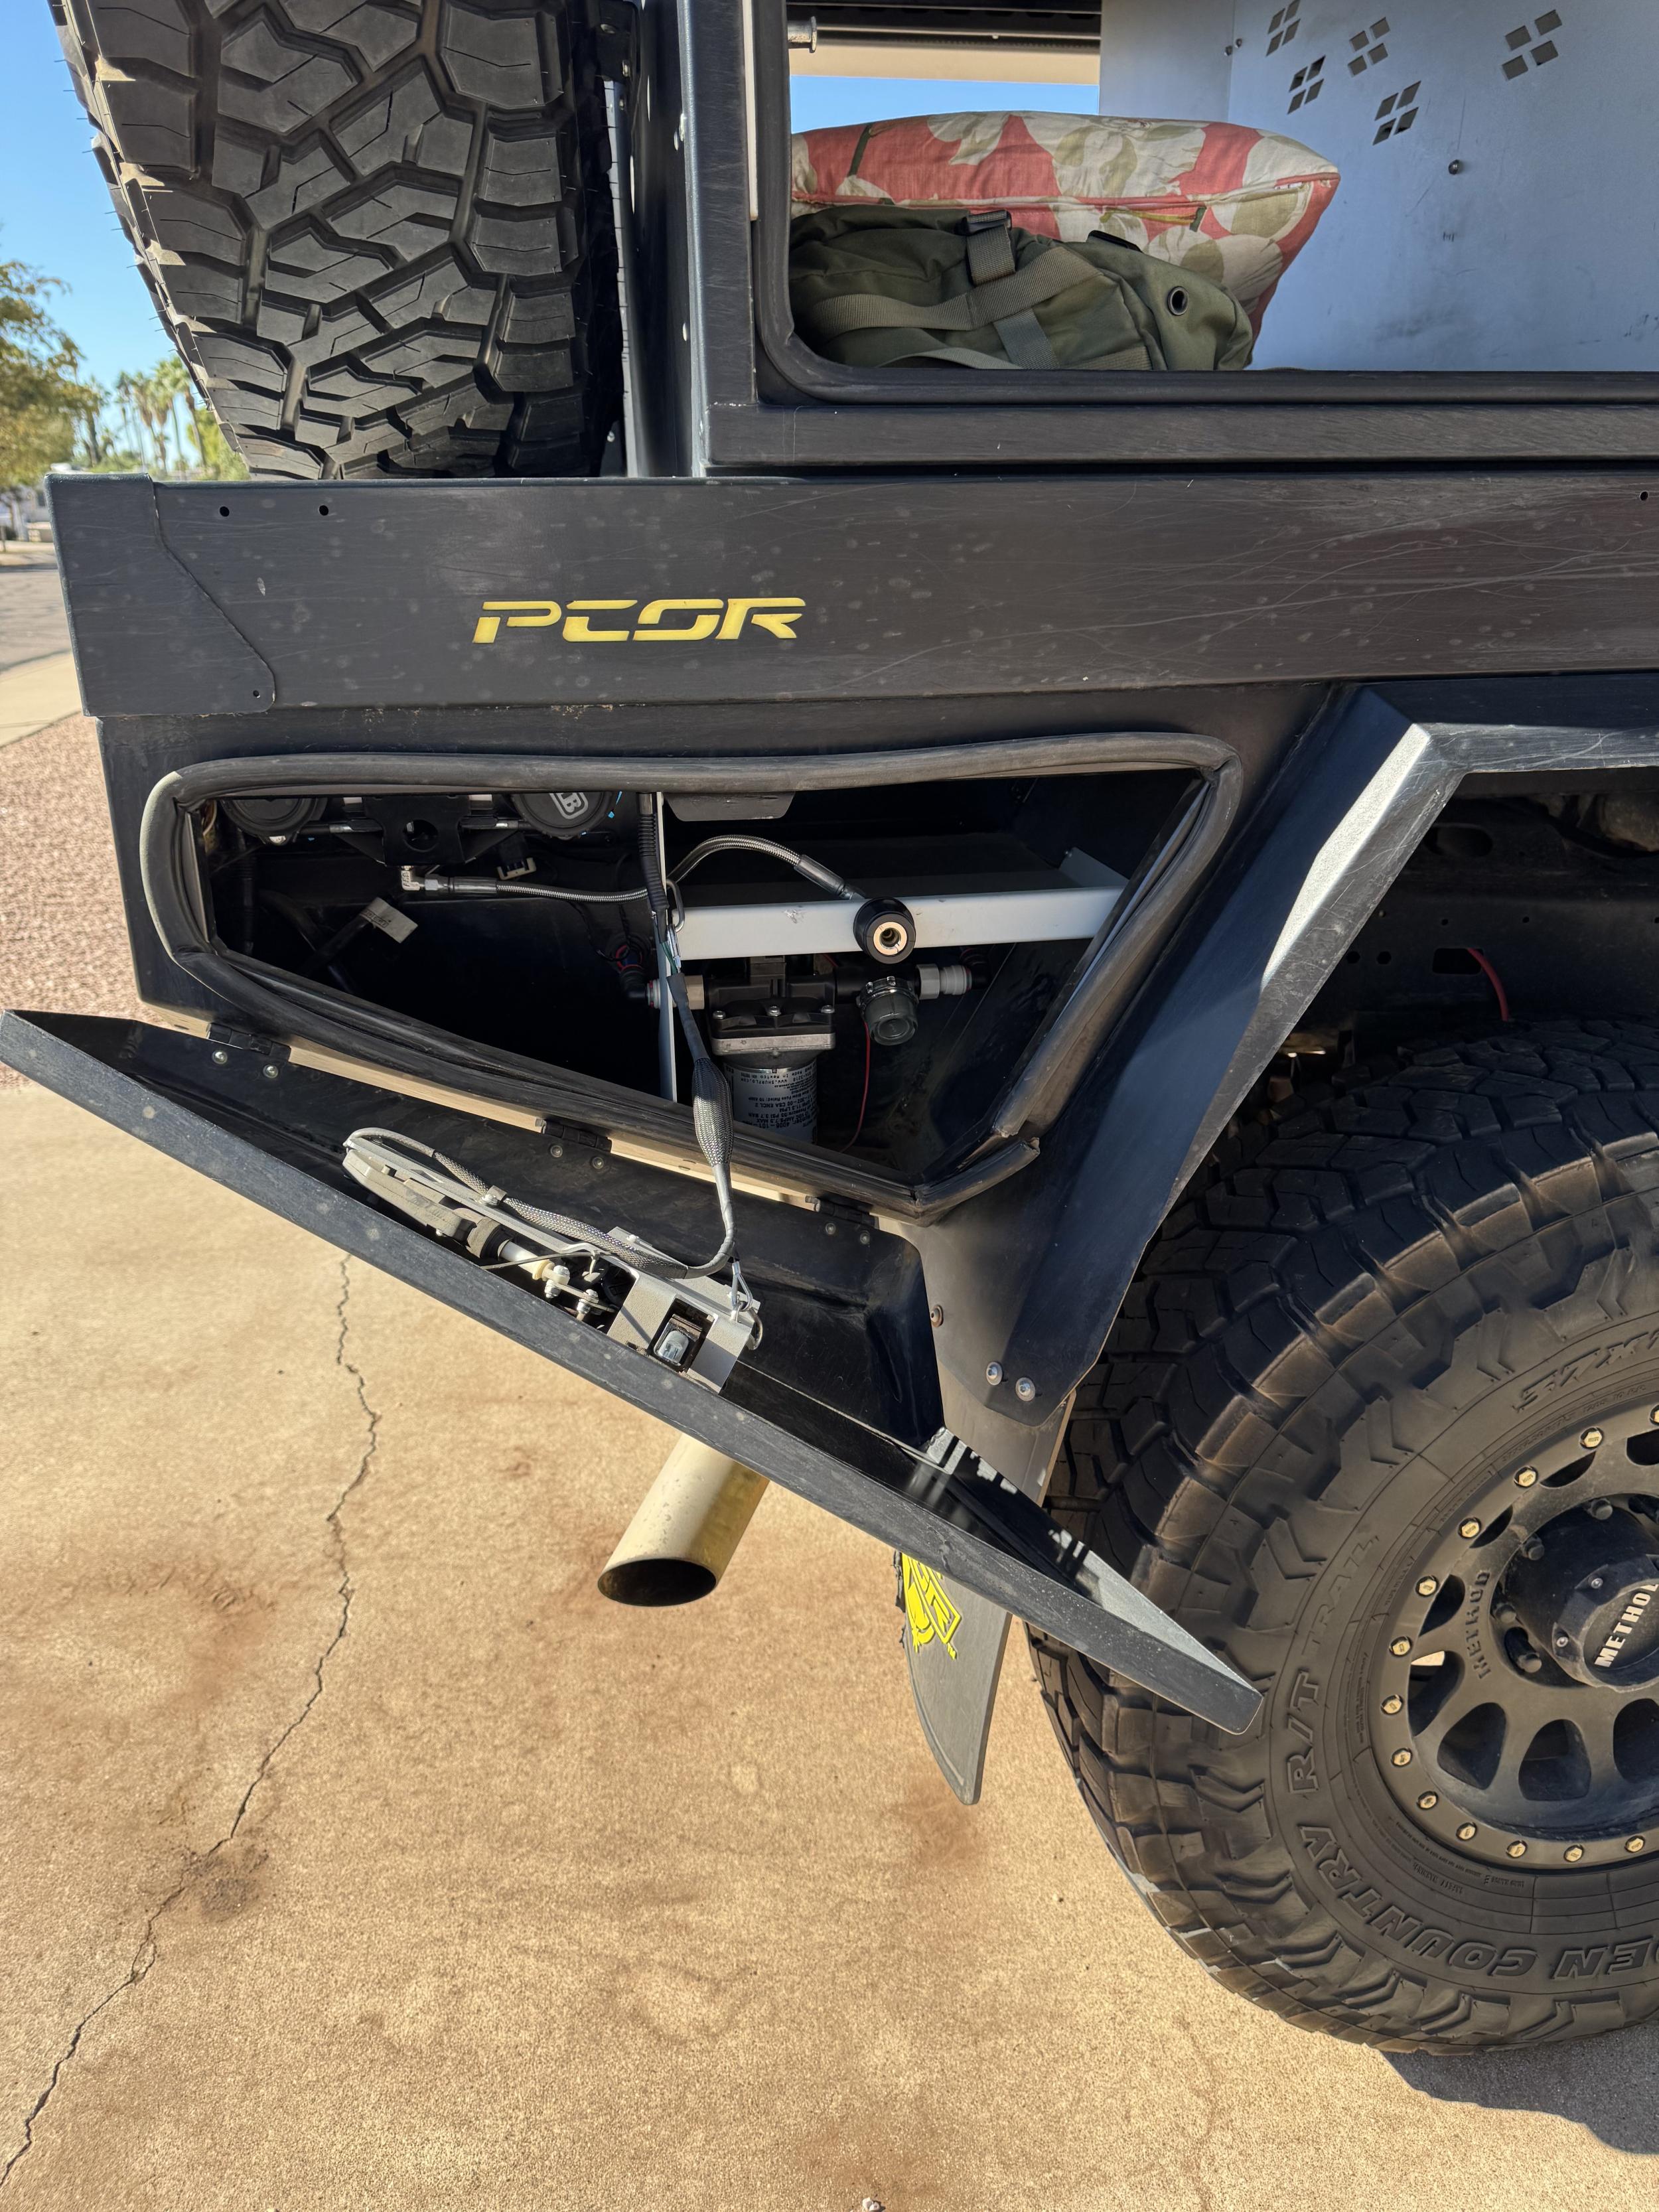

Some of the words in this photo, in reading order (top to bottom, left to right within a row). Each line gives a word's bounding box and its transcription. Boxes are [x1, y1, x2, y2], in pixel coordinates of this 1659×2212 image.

[472, 597, 806, 643] PCOR
[1284, 1668, 1321, 1795] R/T
[1296, 1824, 1540, 1978] COUNTRY
[1551, 1935, 1659, 1980] EN
